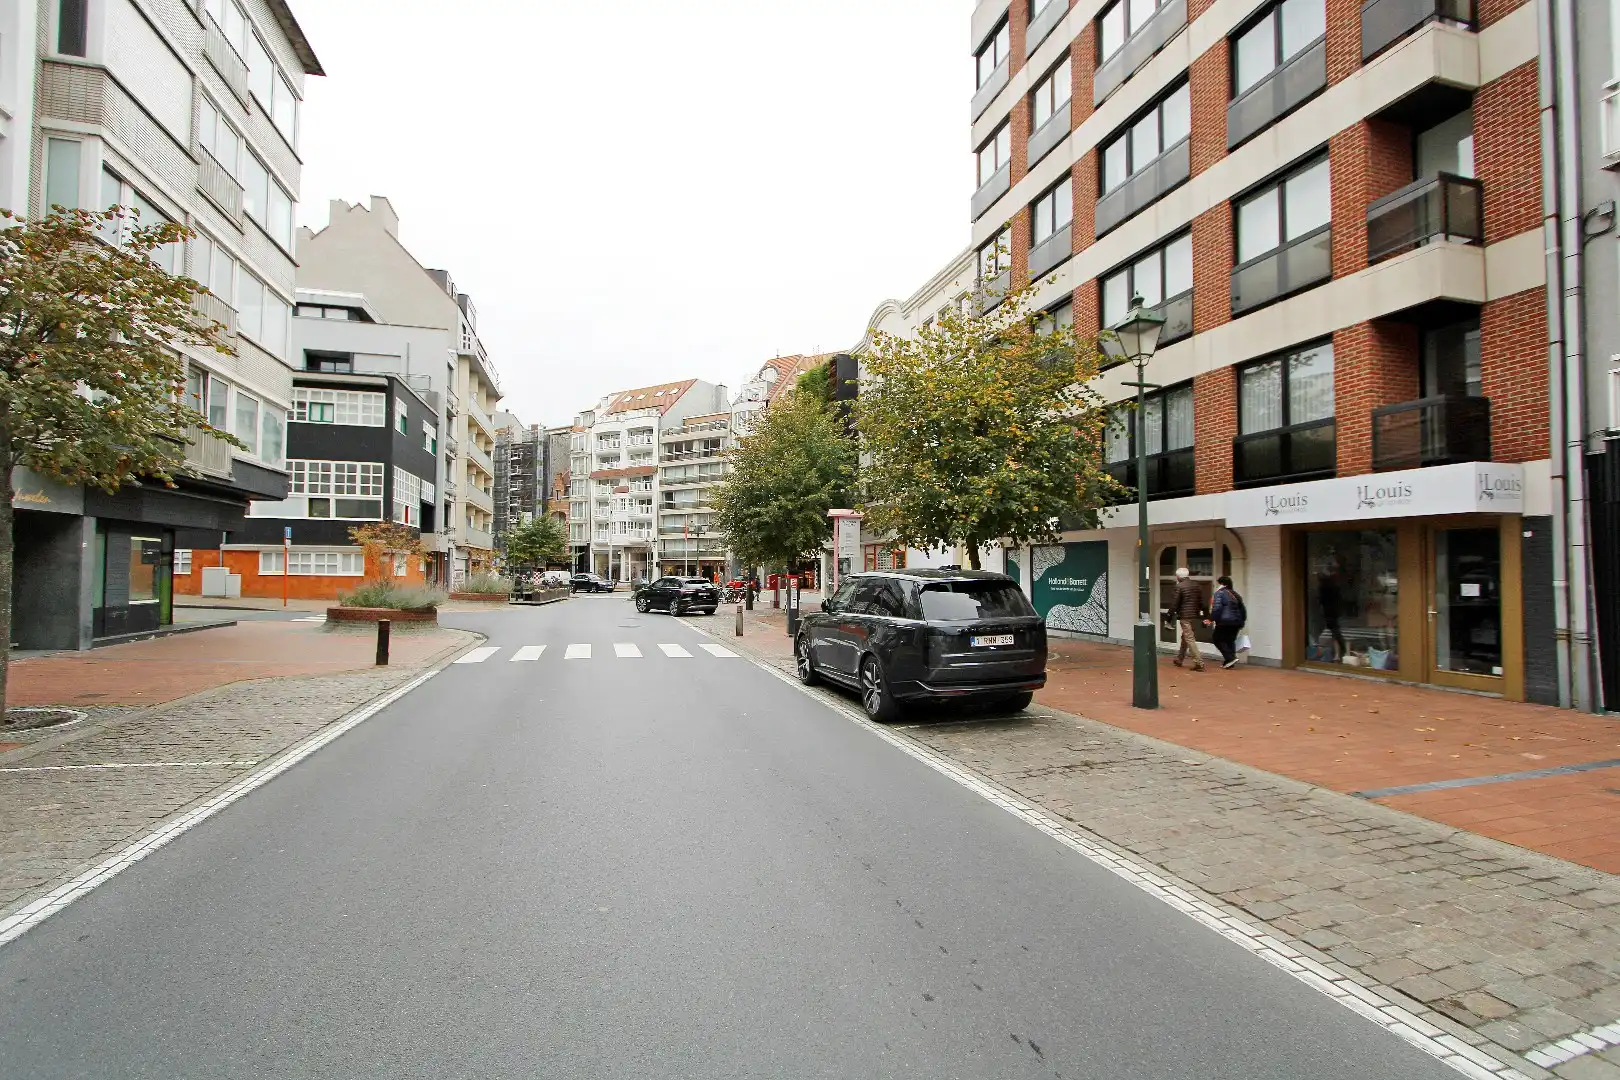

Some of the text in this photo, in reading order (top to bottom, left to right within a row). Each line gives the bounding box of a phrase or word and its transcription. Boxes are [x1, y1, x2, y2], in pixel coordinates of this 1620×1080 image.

[1364, 481, 1412, 500] Louis
[1484, 473, 1522, 491] Louis
[1269, 491, 1309, 509] Louis
[1048, 577, 1067, 585] Holland
[1069, 577, 1087, 586] Barrett
